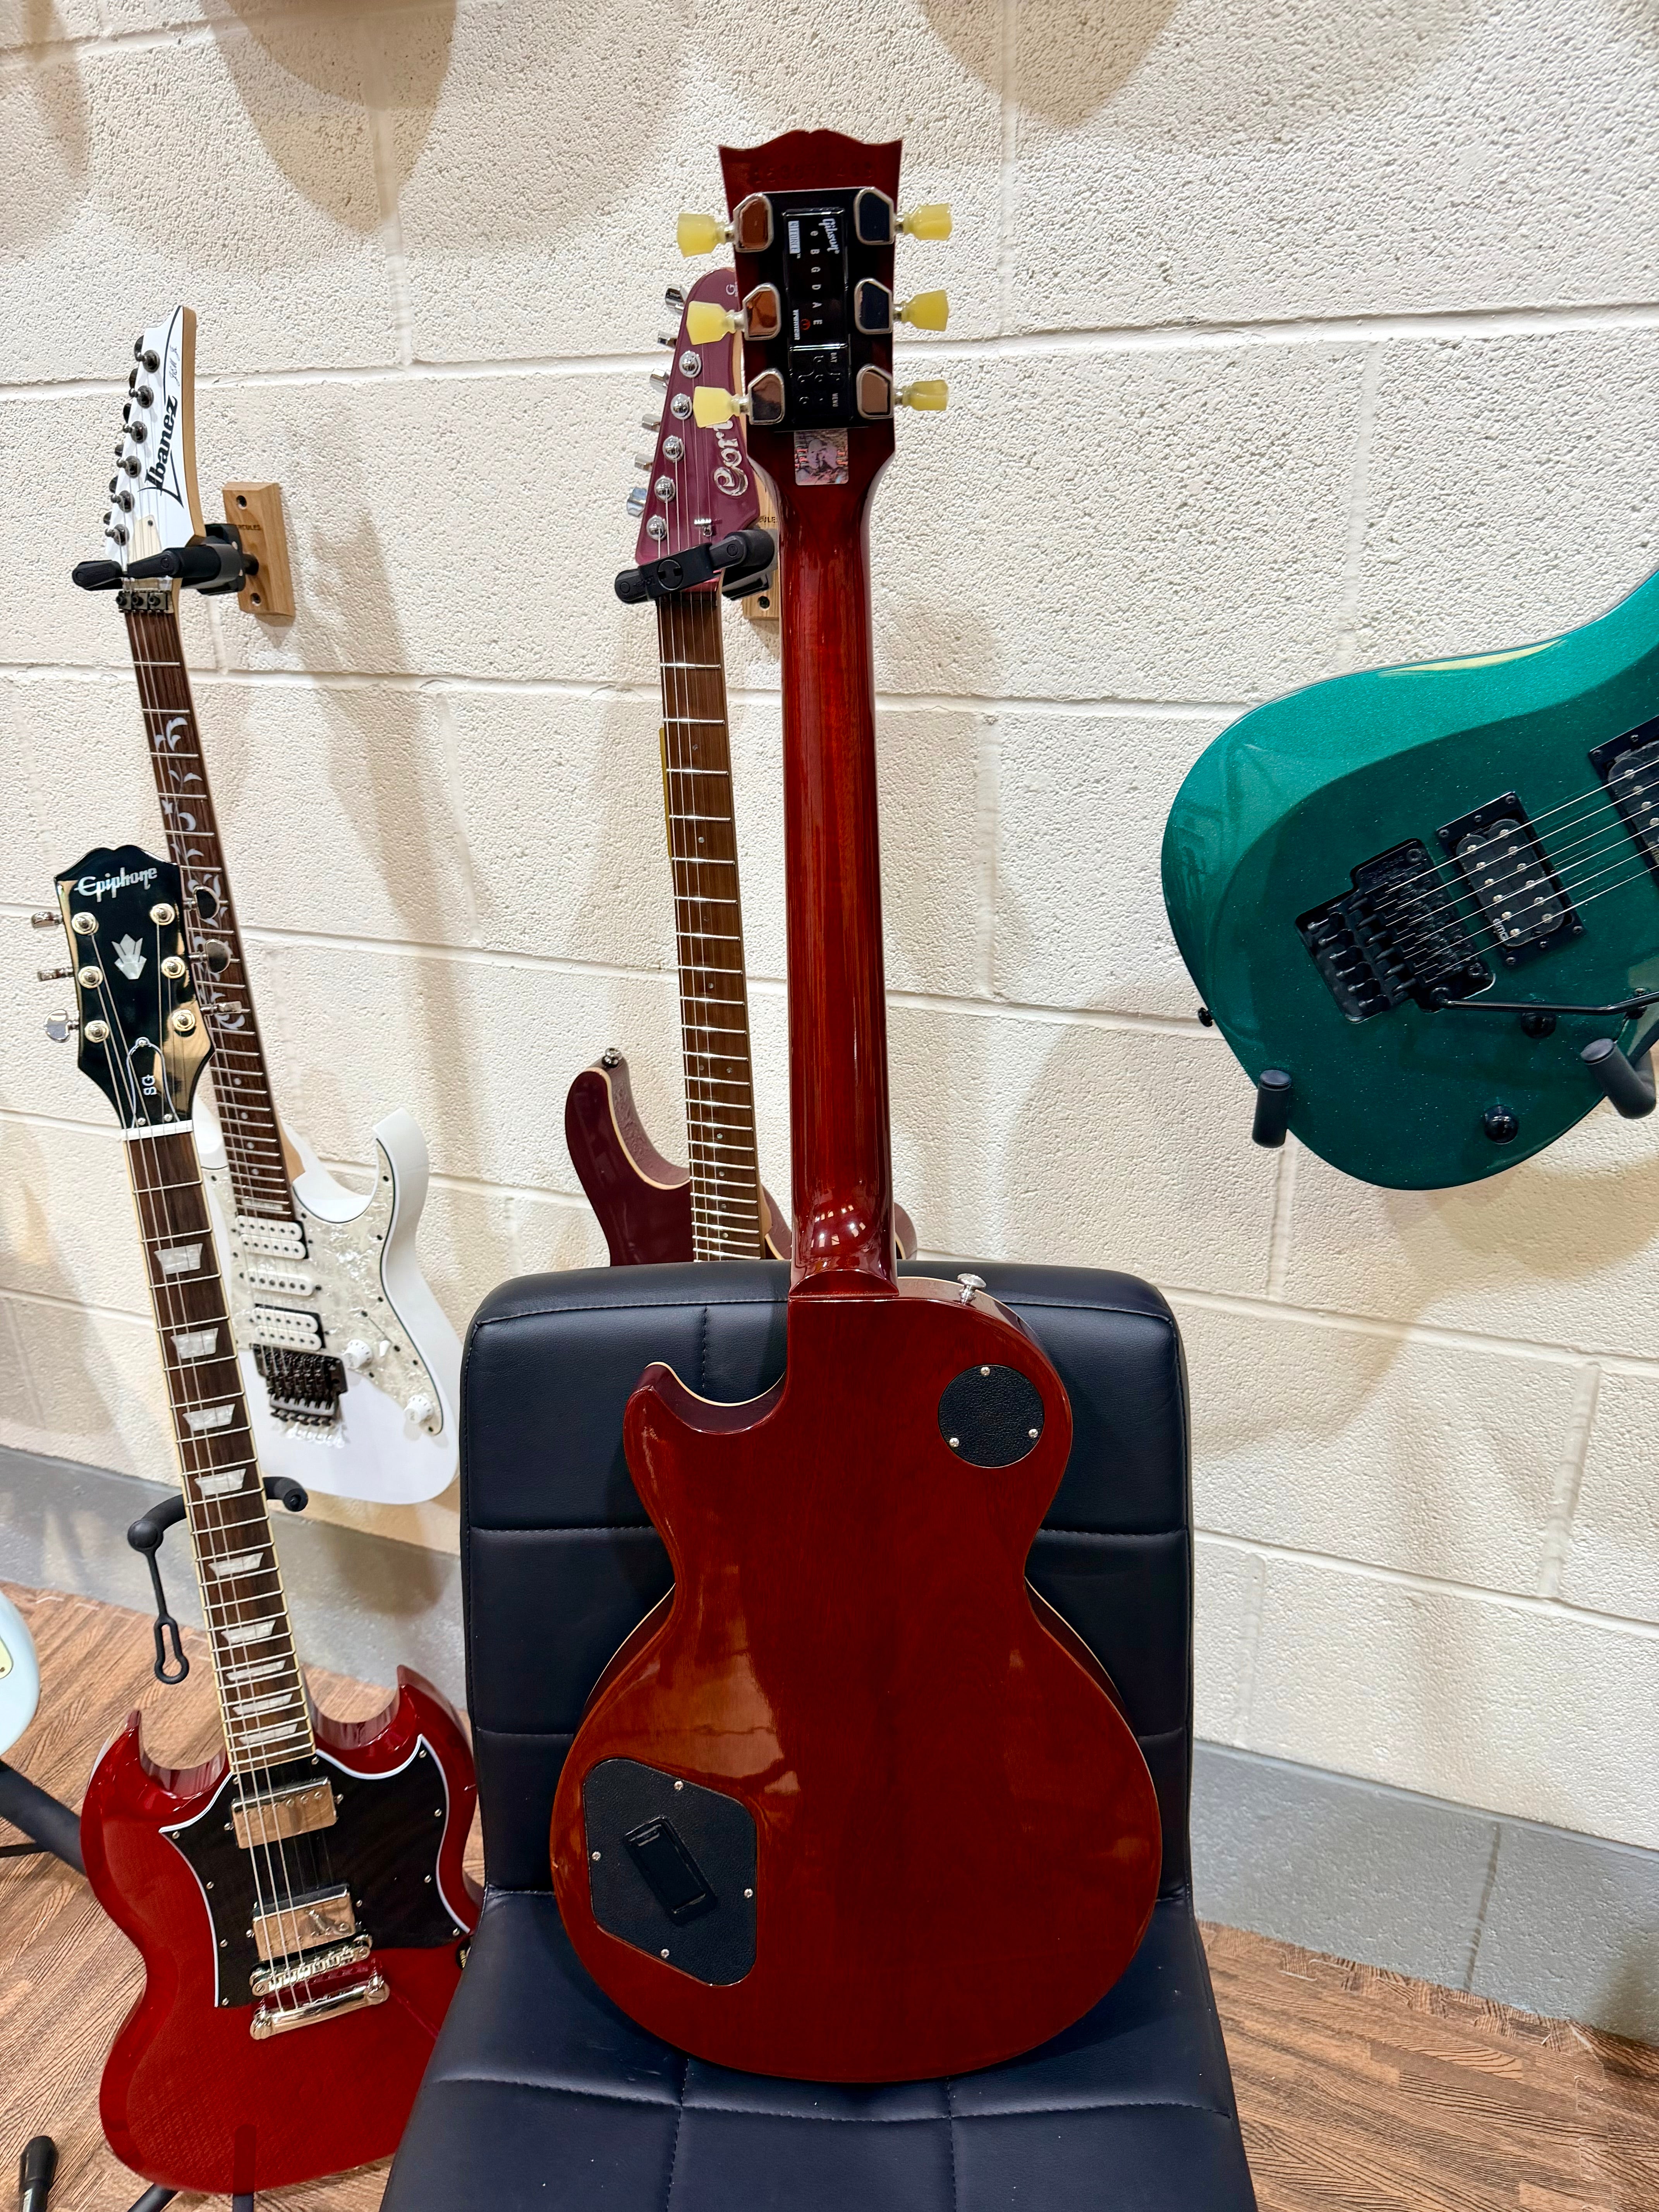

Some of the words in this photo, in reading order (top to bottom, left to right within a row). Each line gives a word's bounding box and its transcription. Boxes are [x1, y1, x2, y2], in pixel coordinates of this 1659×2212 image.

[818, 218, 839, 252] Gibson
[144, 395, 178, 496] Ibanez
[74, 867, 158, 903] Epiphone
[141, 1074, 158, 1096] SG
